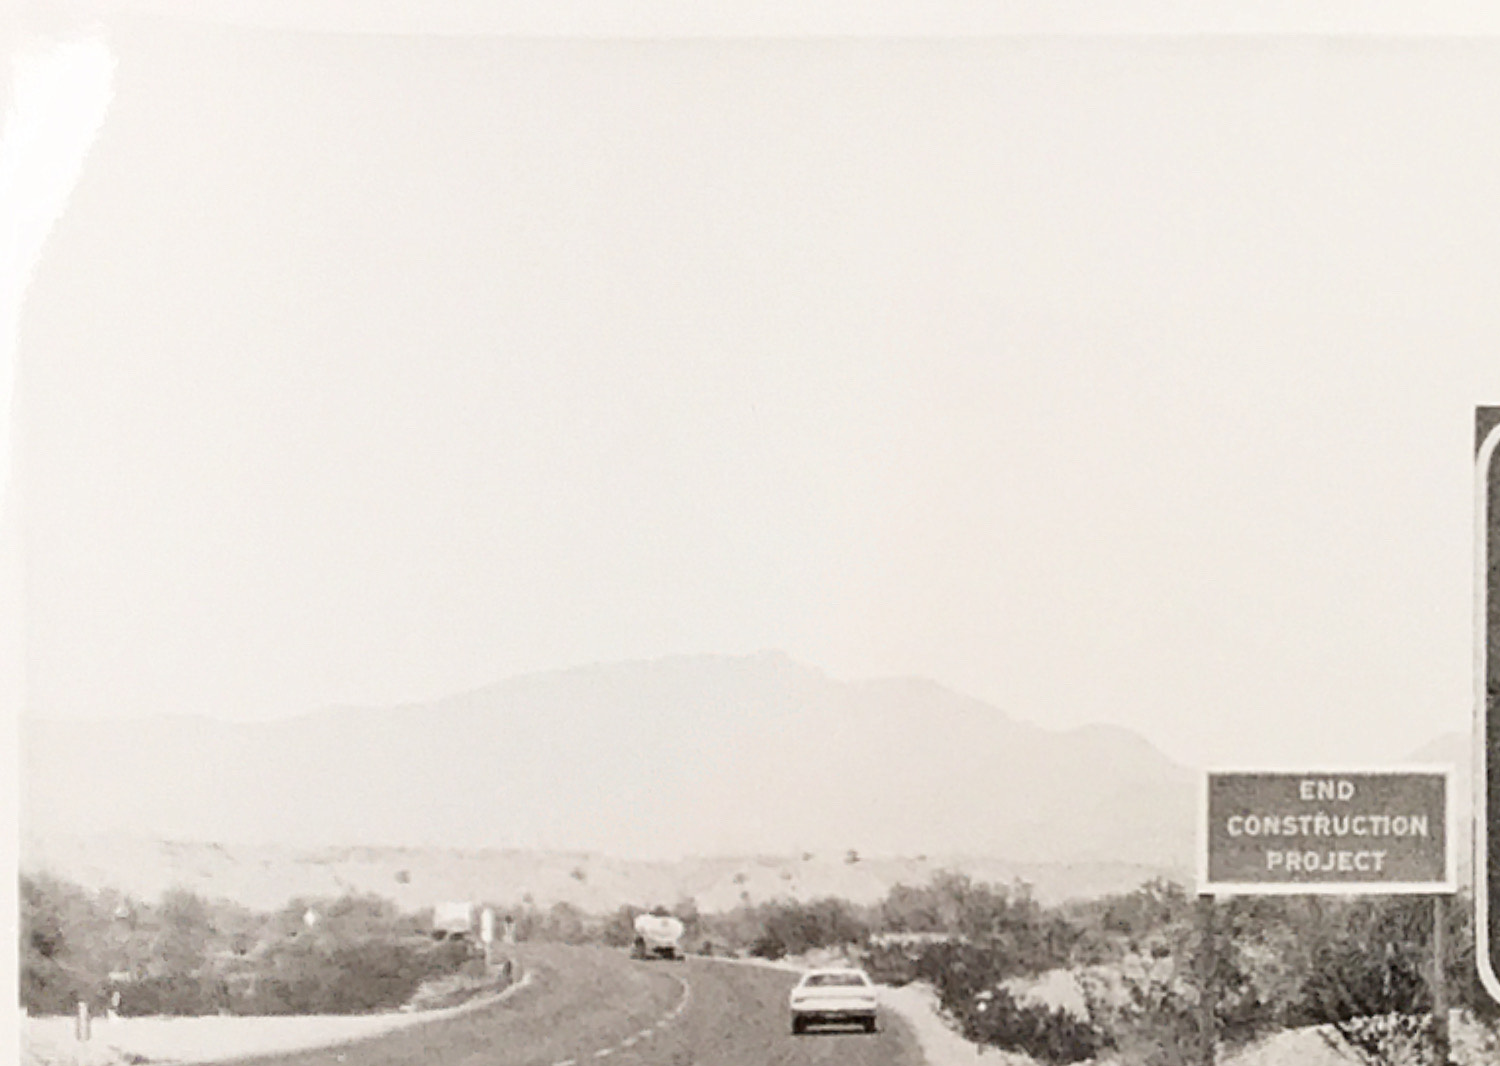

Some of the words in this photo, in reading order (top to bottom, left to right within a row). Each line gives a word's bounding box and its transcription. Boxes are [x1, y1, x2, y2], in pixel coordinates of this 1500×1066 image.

[1299, 779, 1355, 801] END
[1226, 814, 1429, 836] CONSTRUCTION
[1265, 850, 1388, 872] PROJECT
